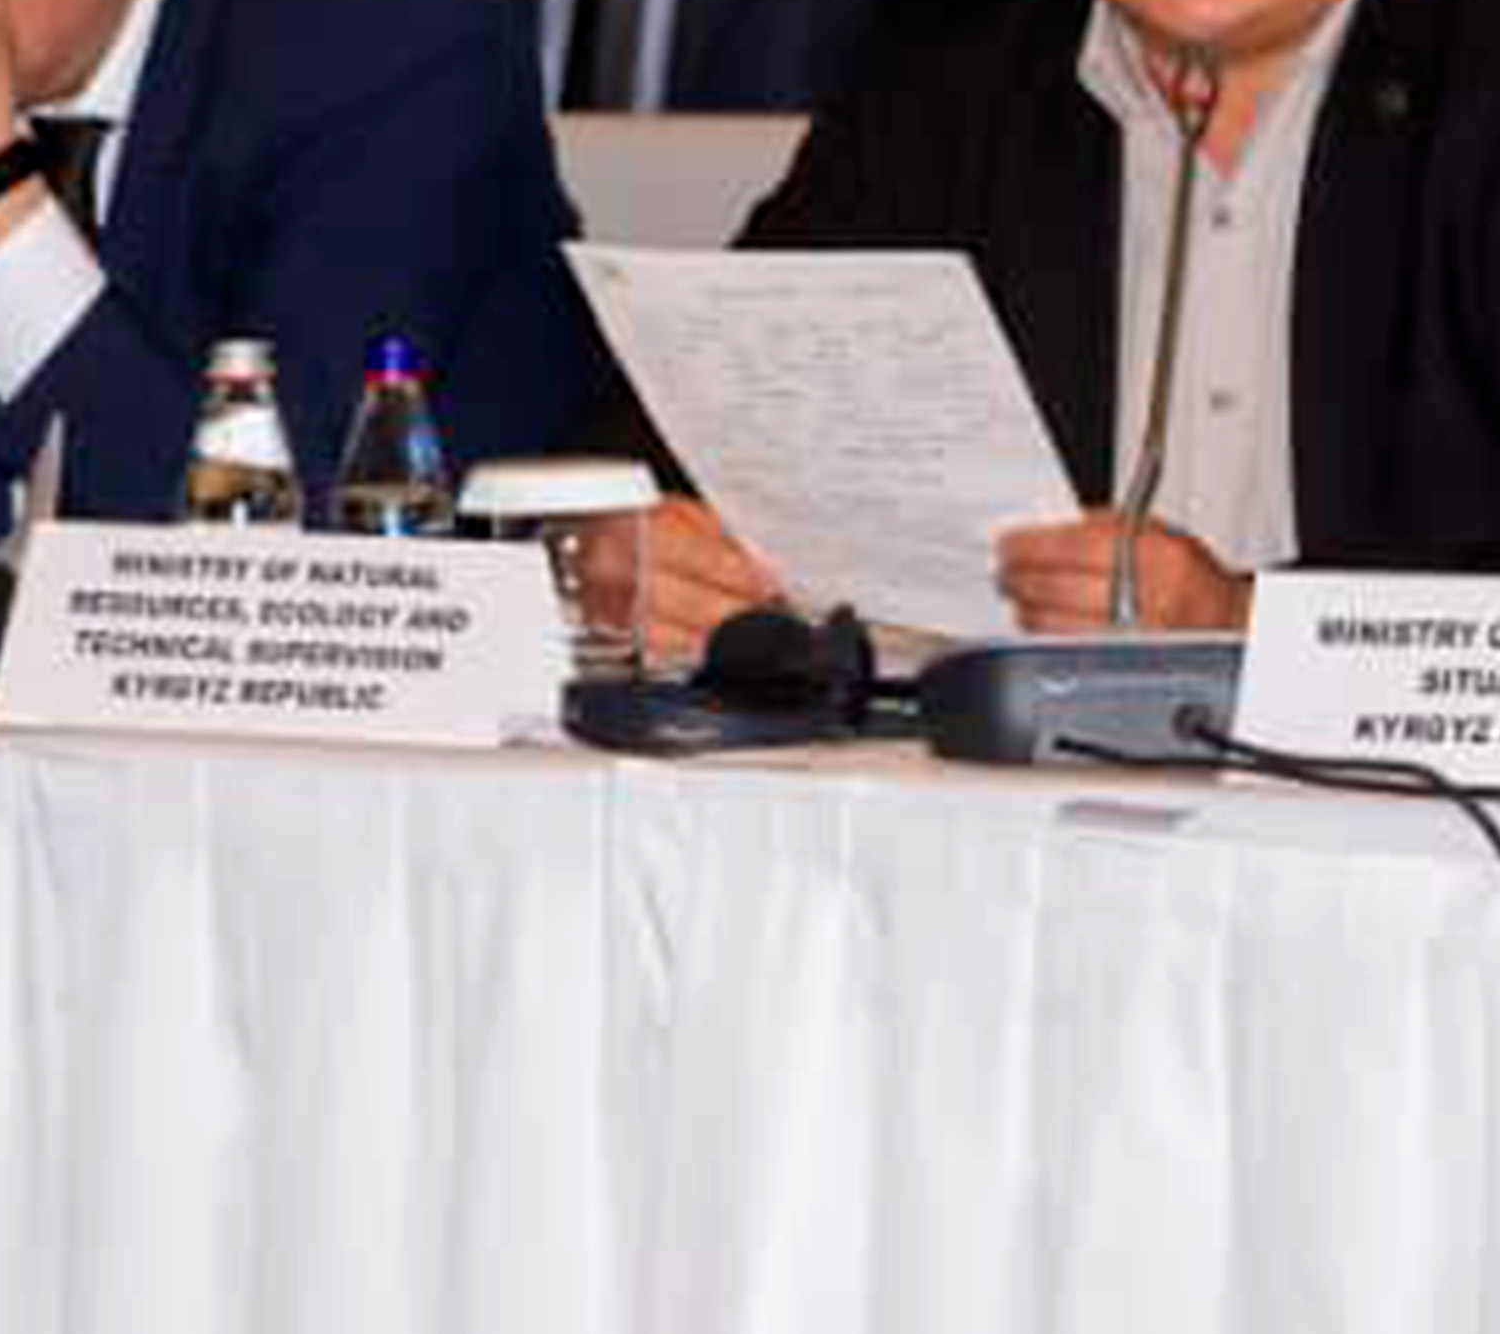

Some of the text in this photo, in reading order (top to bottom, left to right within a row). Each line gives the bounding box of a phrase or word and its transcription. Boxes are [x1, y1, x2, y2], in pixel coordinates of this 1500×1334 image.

[113, 551, 440, 590] MINISTRY OF NATURAL
[69, 589, 470, 634] RESOURCES, ECOLOGY AND
[73, 629, 443, 671] TECHNICAL SUPERVISION
[1317, 617, 1478, 648] MINISTRY
[112, 673, 387, 711] KYRGYZ REPUBLIC
[1355, 713, 1492, 745] KYRGYZ
